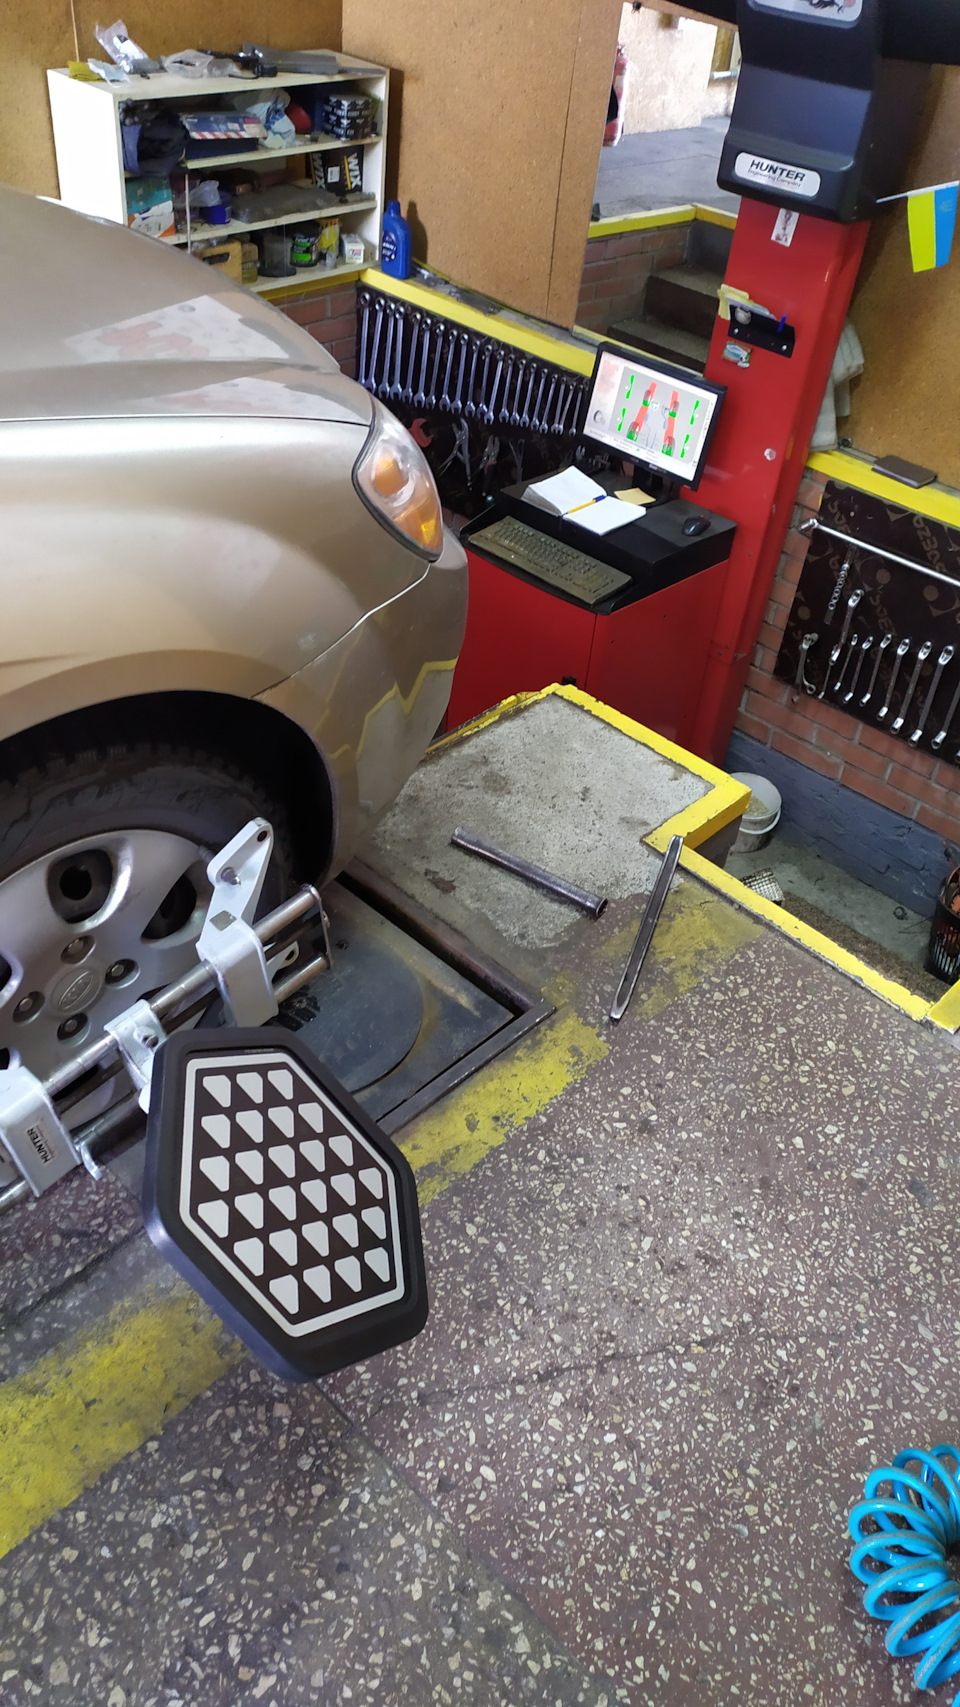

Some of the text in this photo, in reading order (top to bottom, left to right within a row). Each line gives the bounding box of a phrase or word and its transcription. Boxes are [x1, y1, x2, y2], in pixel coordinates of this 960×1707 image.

[347, 153, 362, 189] WIX
[750, 160, 806, 182] HUNTER
[777, 175, 802, 188] Company
[26, 1127, 51, 1164] HUNTER
